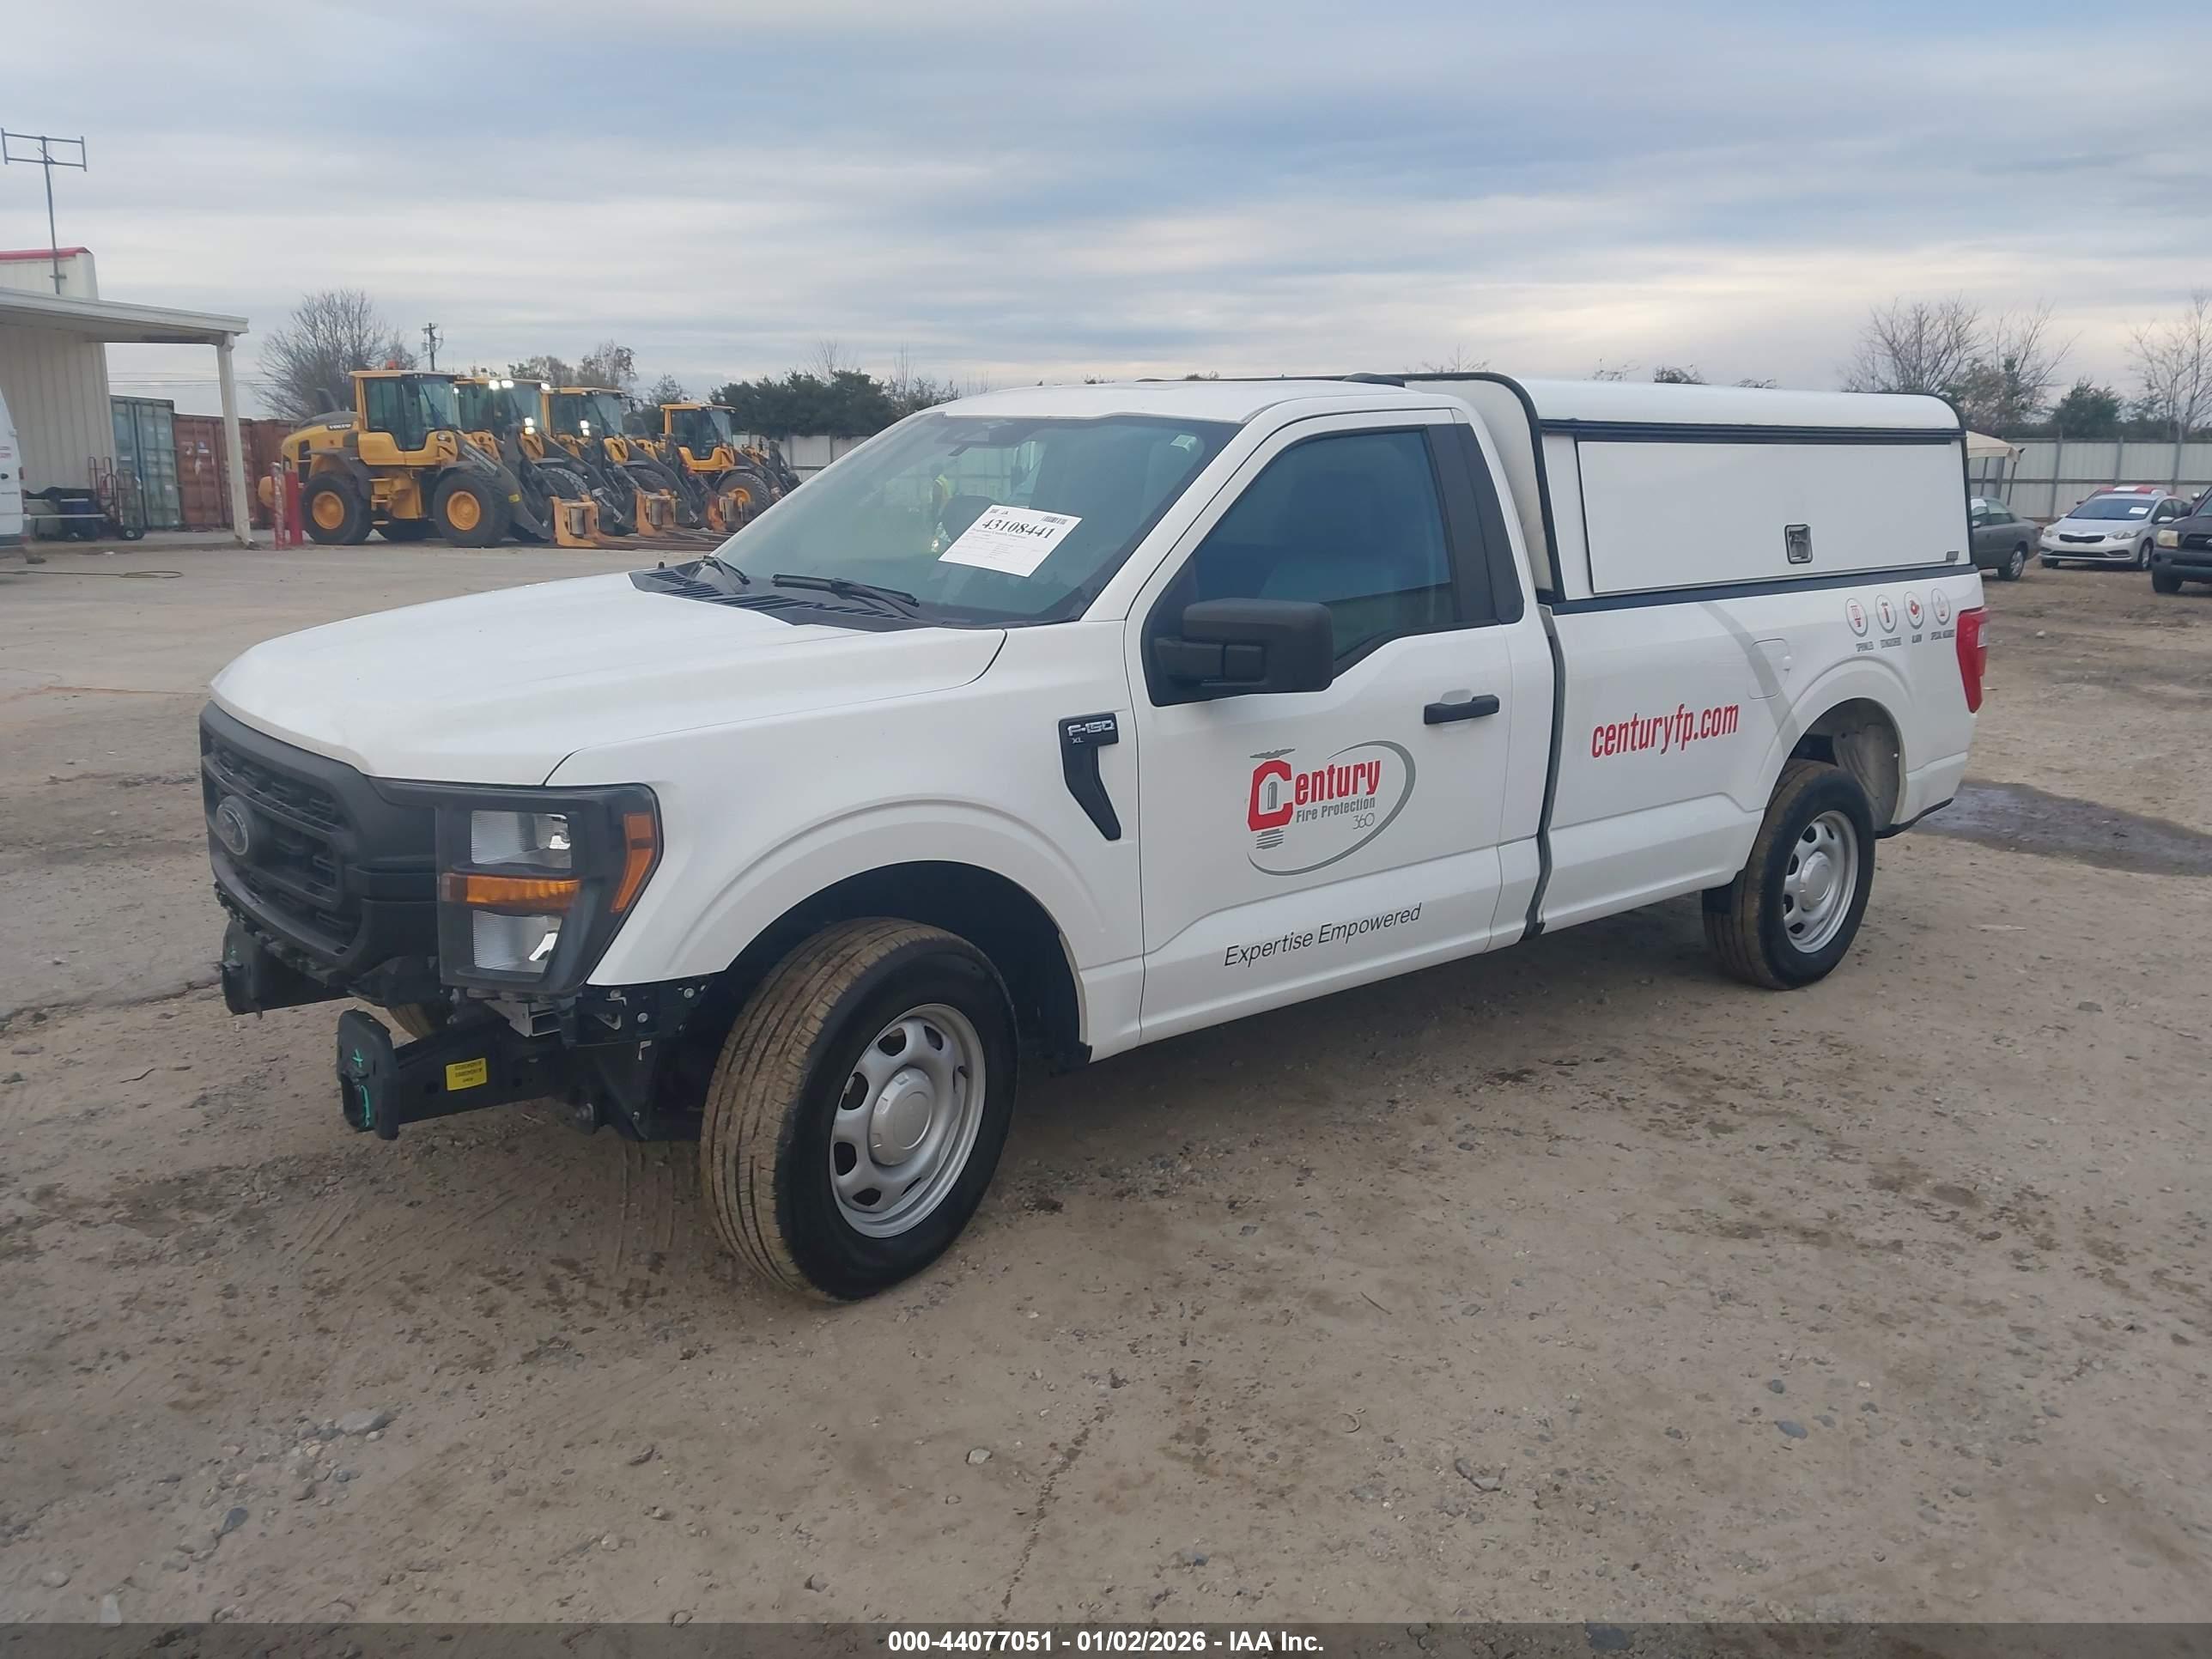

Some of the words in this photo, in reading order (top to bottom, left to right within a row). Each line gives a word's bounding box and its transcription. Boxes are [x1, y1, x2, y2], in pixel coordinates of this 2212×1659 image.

[981, 519, 1056, 538] 43108441
[1066, 720, 1115, 737] F-150
[1591, 703, 1739, 759] centuryfp.com
[1248, 759, 1381, 831] Century
[1296, 808, 1318, 823] Fire
[1321, 797, 1376, 818] Protection
[1352, 812, 1376, 830] 360
[1224, 932, 1313, 968] Expertise
[1317, 902, 1423, 945] Empowered
